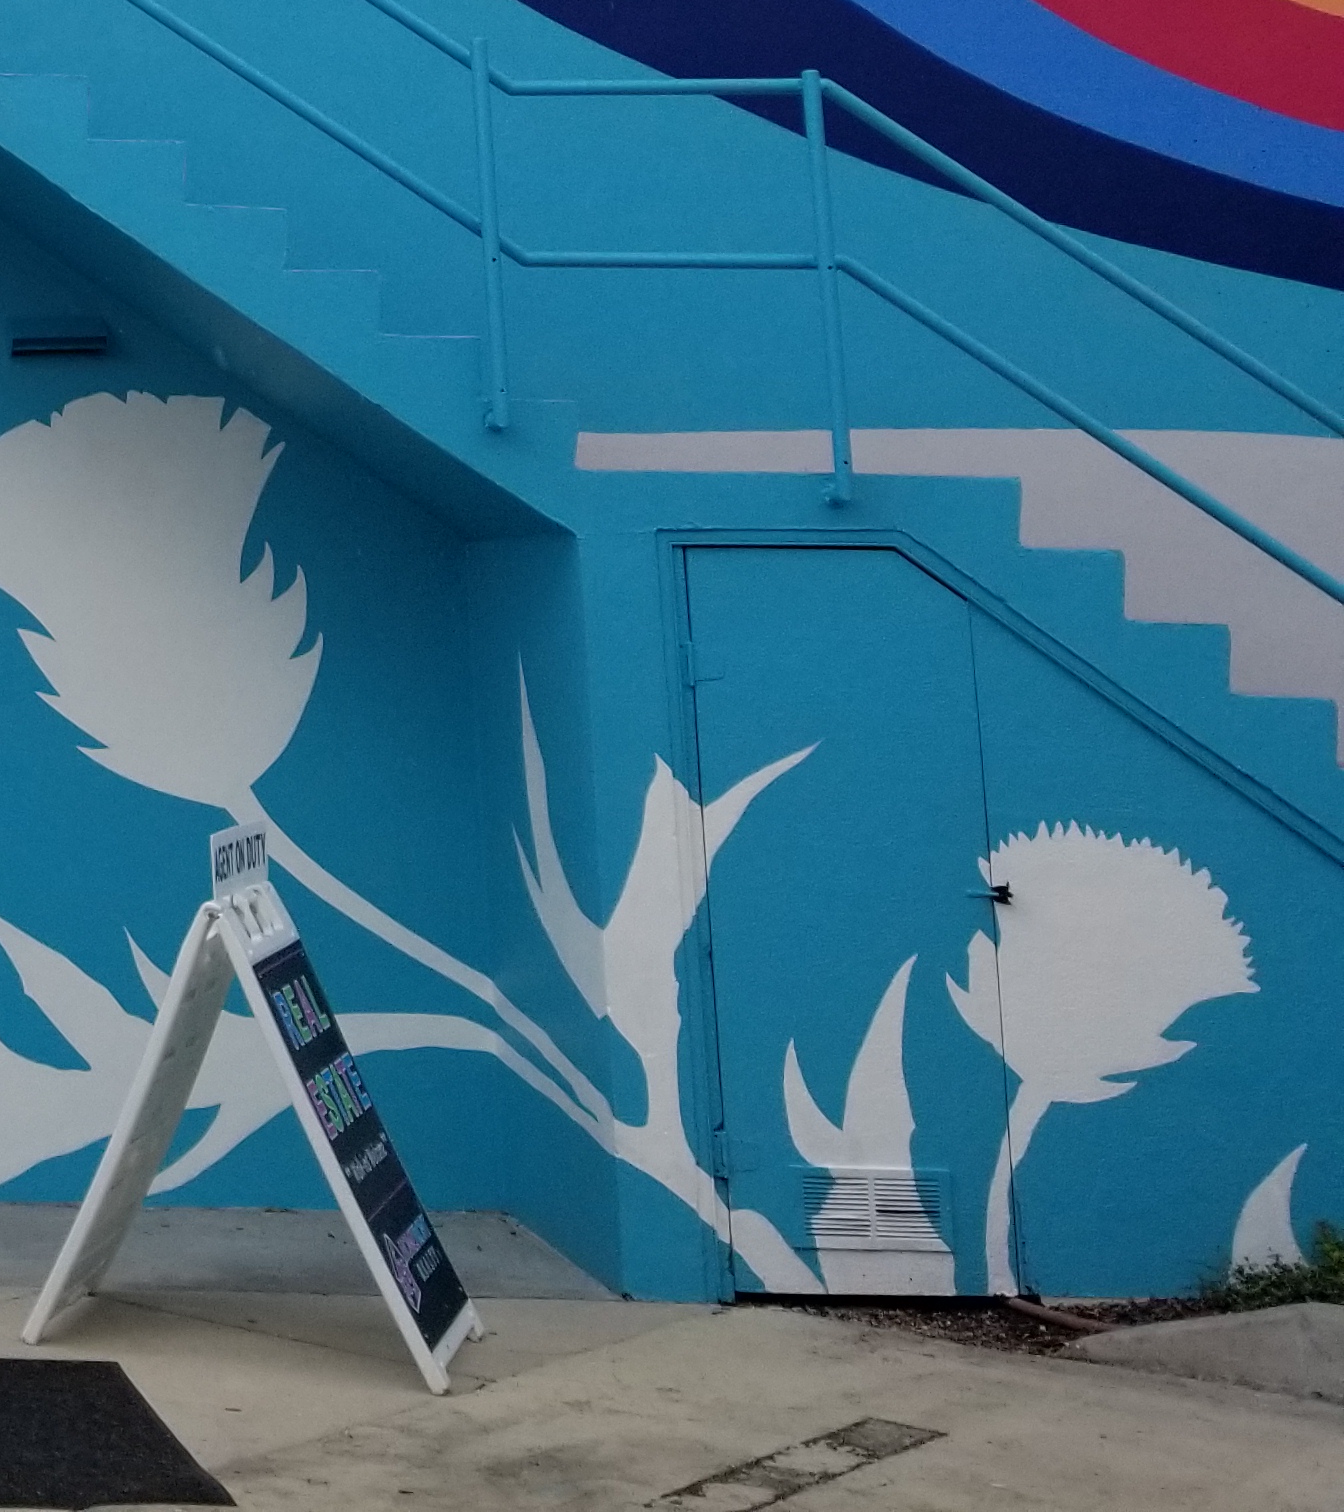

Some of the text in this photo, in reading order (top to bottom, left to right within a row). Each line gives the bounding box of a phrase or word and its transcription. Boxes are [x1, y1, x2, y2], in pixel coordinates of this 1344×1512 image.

[215, 832, 266, 884] AGENT ON DUTY
[271, 974, 332, 1051] REAL
[306, 1051, 373, 1141] ESTATE
